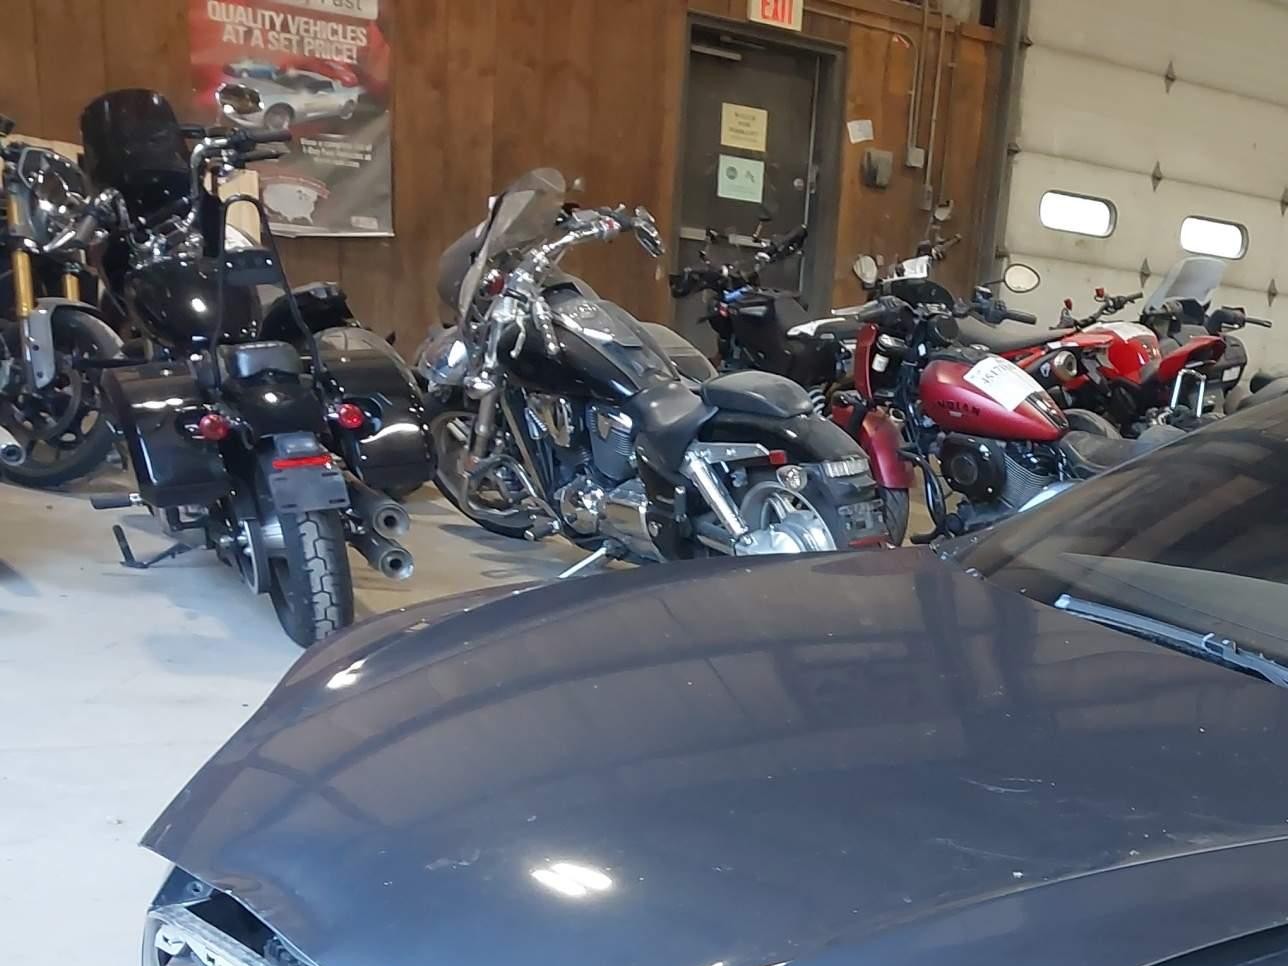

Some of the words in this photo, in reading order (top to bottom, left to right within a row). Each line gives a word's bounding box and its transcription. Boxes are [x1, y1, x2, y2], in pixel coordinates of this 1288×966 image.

[207, 1, 285, 32] QUALITY
[286, 14, 368, 47] VEHICLES
[222, 24, 248, 45] AT
[250, 29, 265, 49] A
[267, 31, 300, 55] SET
[303, 37, 359, 65] PRICE!
